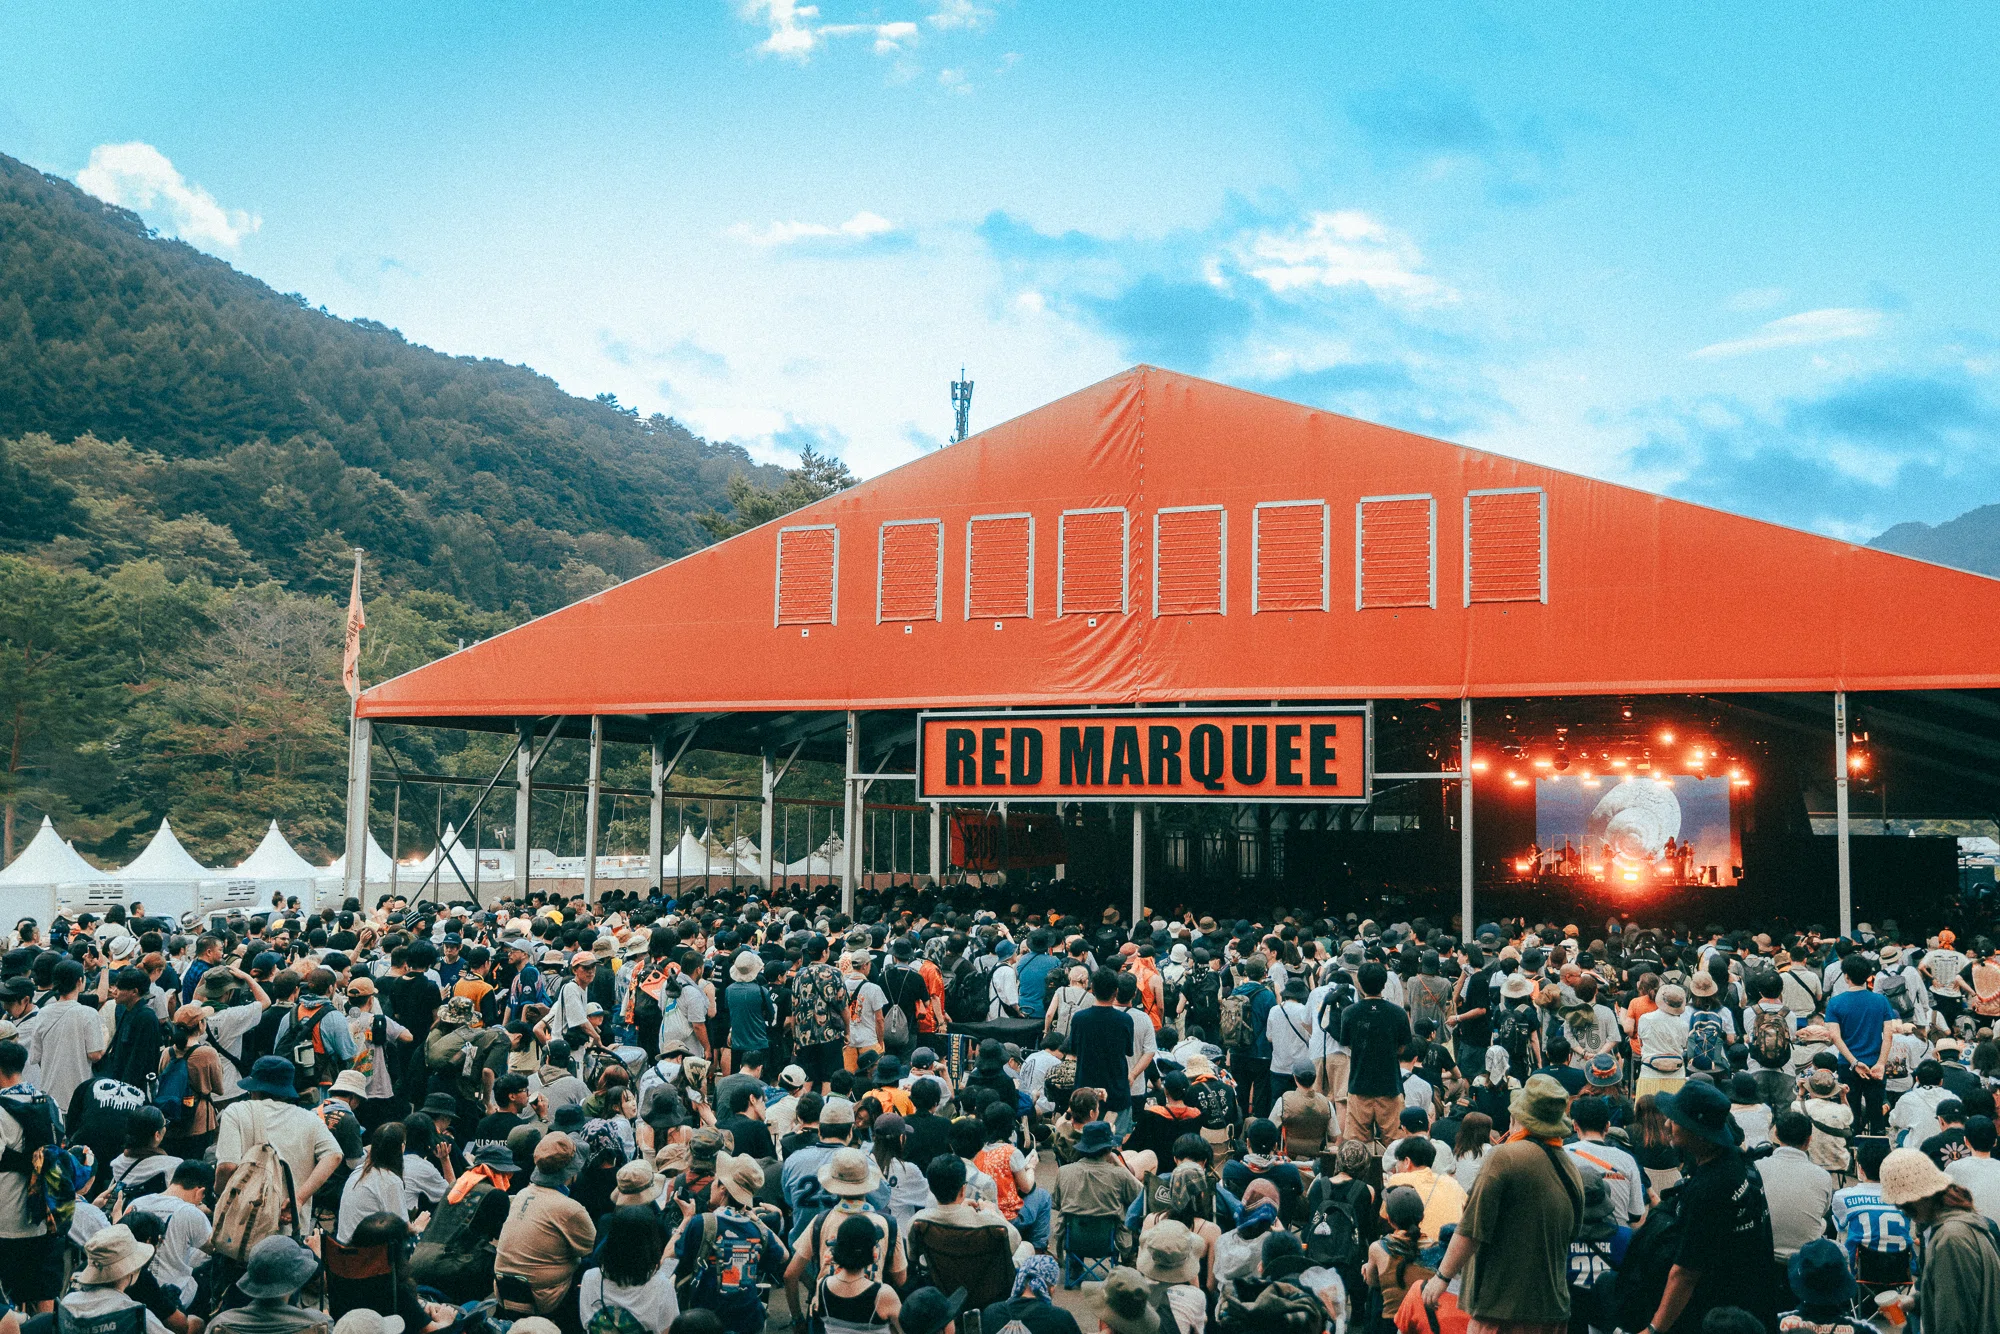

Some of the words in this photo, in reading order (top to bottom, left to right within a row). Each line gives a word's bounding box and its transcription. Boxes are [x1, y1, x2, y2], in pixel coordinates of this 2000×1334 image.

[945, 727, 1043, 786] RED
[1059, 723, 1338, 790] MARQUEE
[1858, 1211, 1907, 1252] 16
